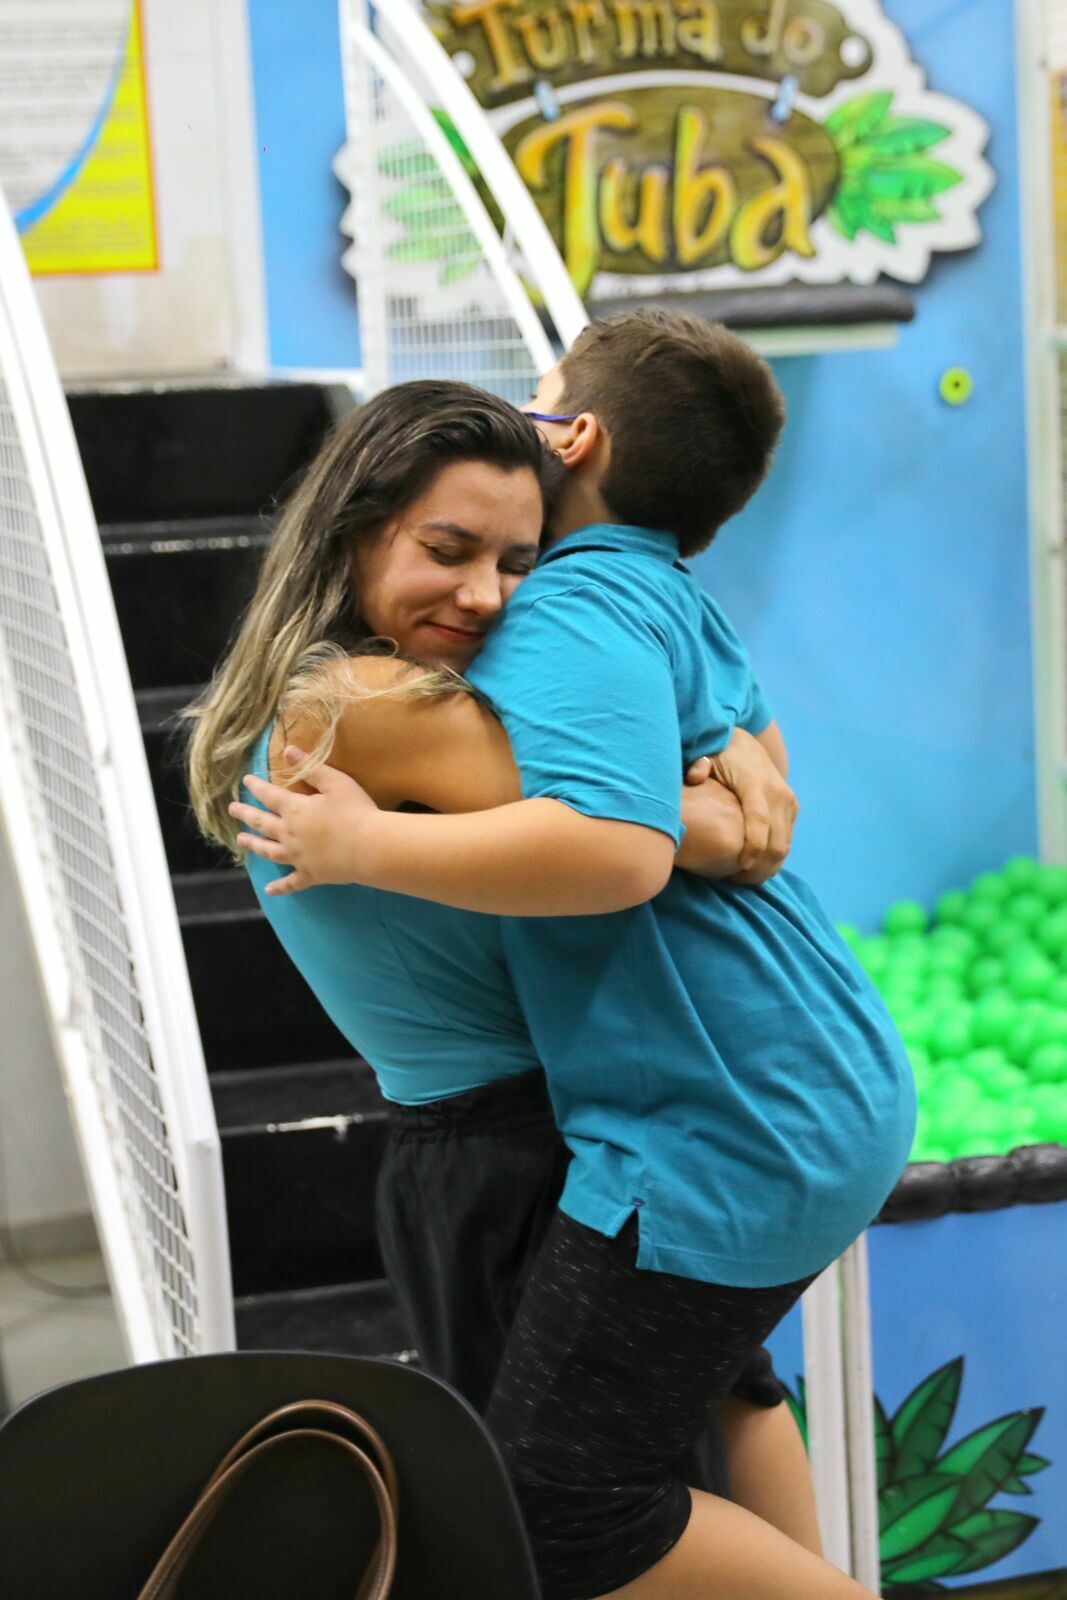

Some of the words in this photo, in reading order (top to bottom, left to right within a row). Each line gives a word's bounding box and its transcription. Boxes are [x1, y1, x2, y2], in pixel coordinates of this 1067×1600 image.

[452, 0, 722, 86] Turma
[740, 0, 826, 65] do
[515, 103, 816, 300] Tuba
